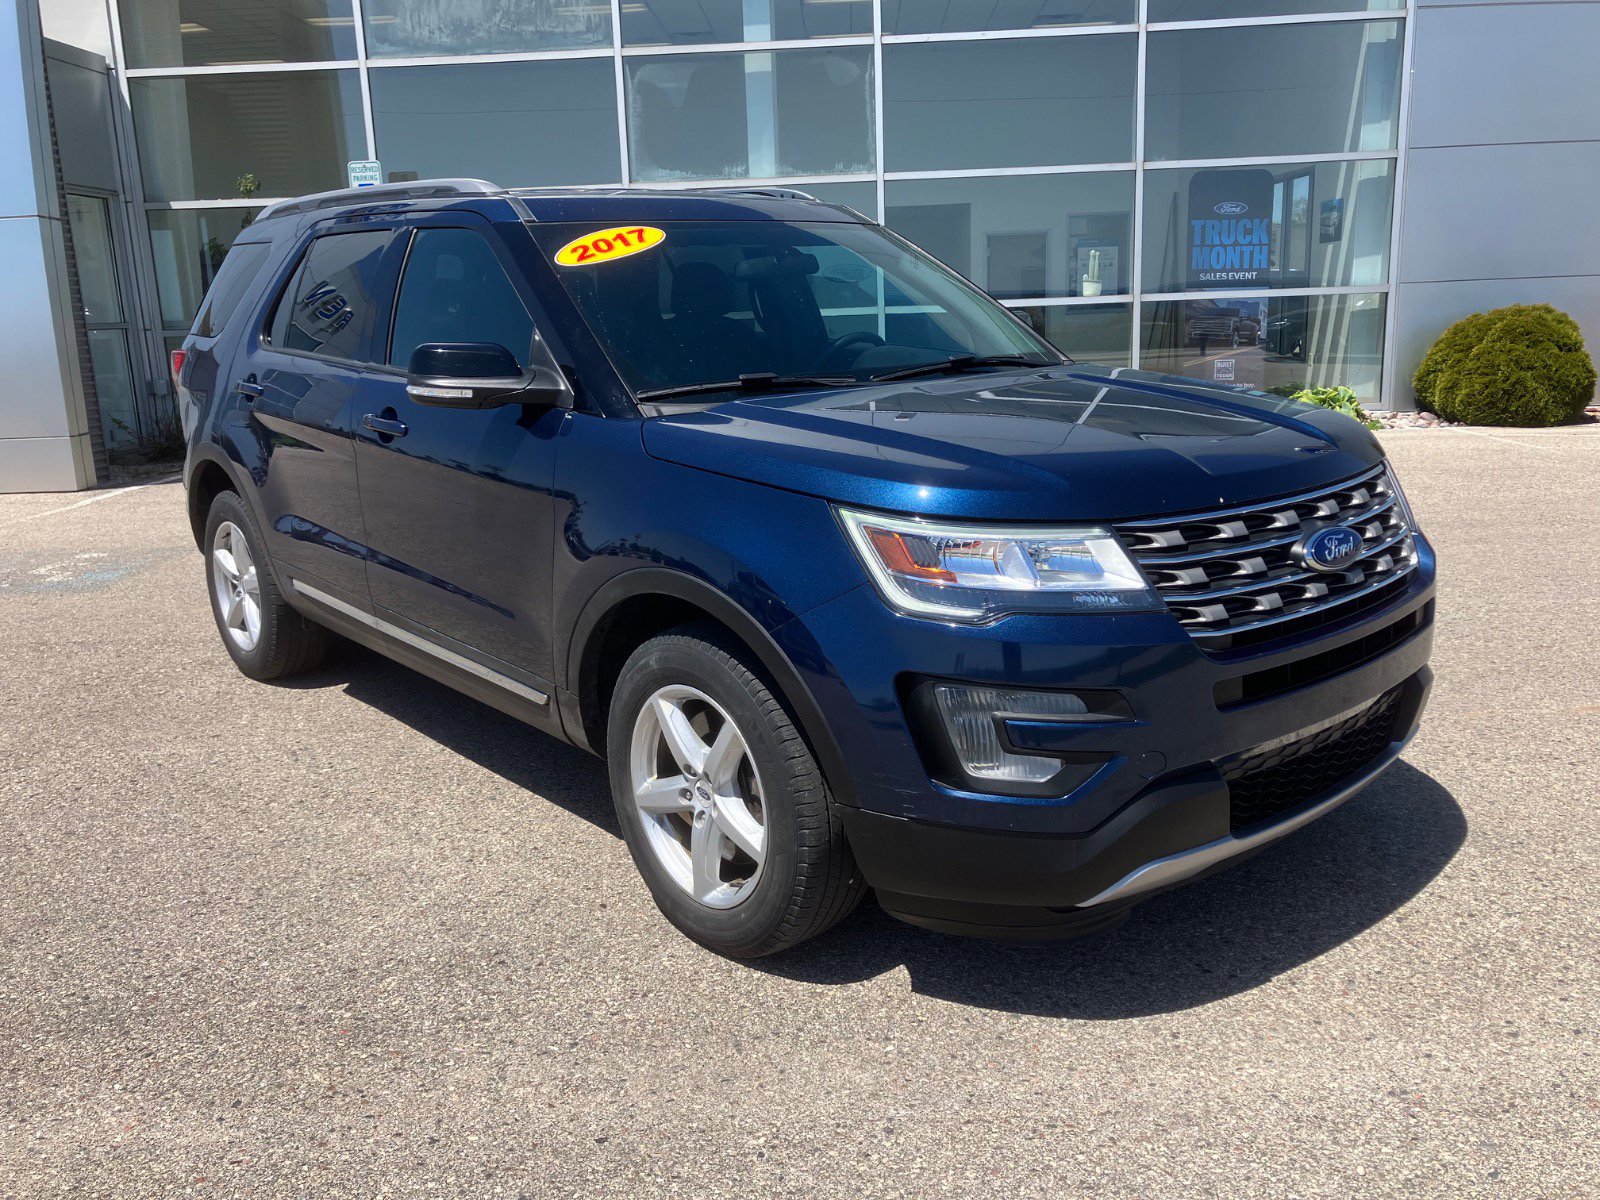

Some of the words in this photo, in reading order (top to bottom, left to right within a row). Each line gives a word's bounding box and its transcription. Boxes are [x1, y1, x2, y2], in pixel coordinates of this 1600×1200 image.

[351, 165, 379, 173] RESERVED
[1191, 218, 1270, 245] TRUCK
[570, 228, 646, 262] 2017
[1191, 245, 1269, 270] MONTH
[1199, 272, 1227, 281] SALES
[1228, 271, 1258, 280] EVENT
[1324, 533, 1354, 561] Ford
